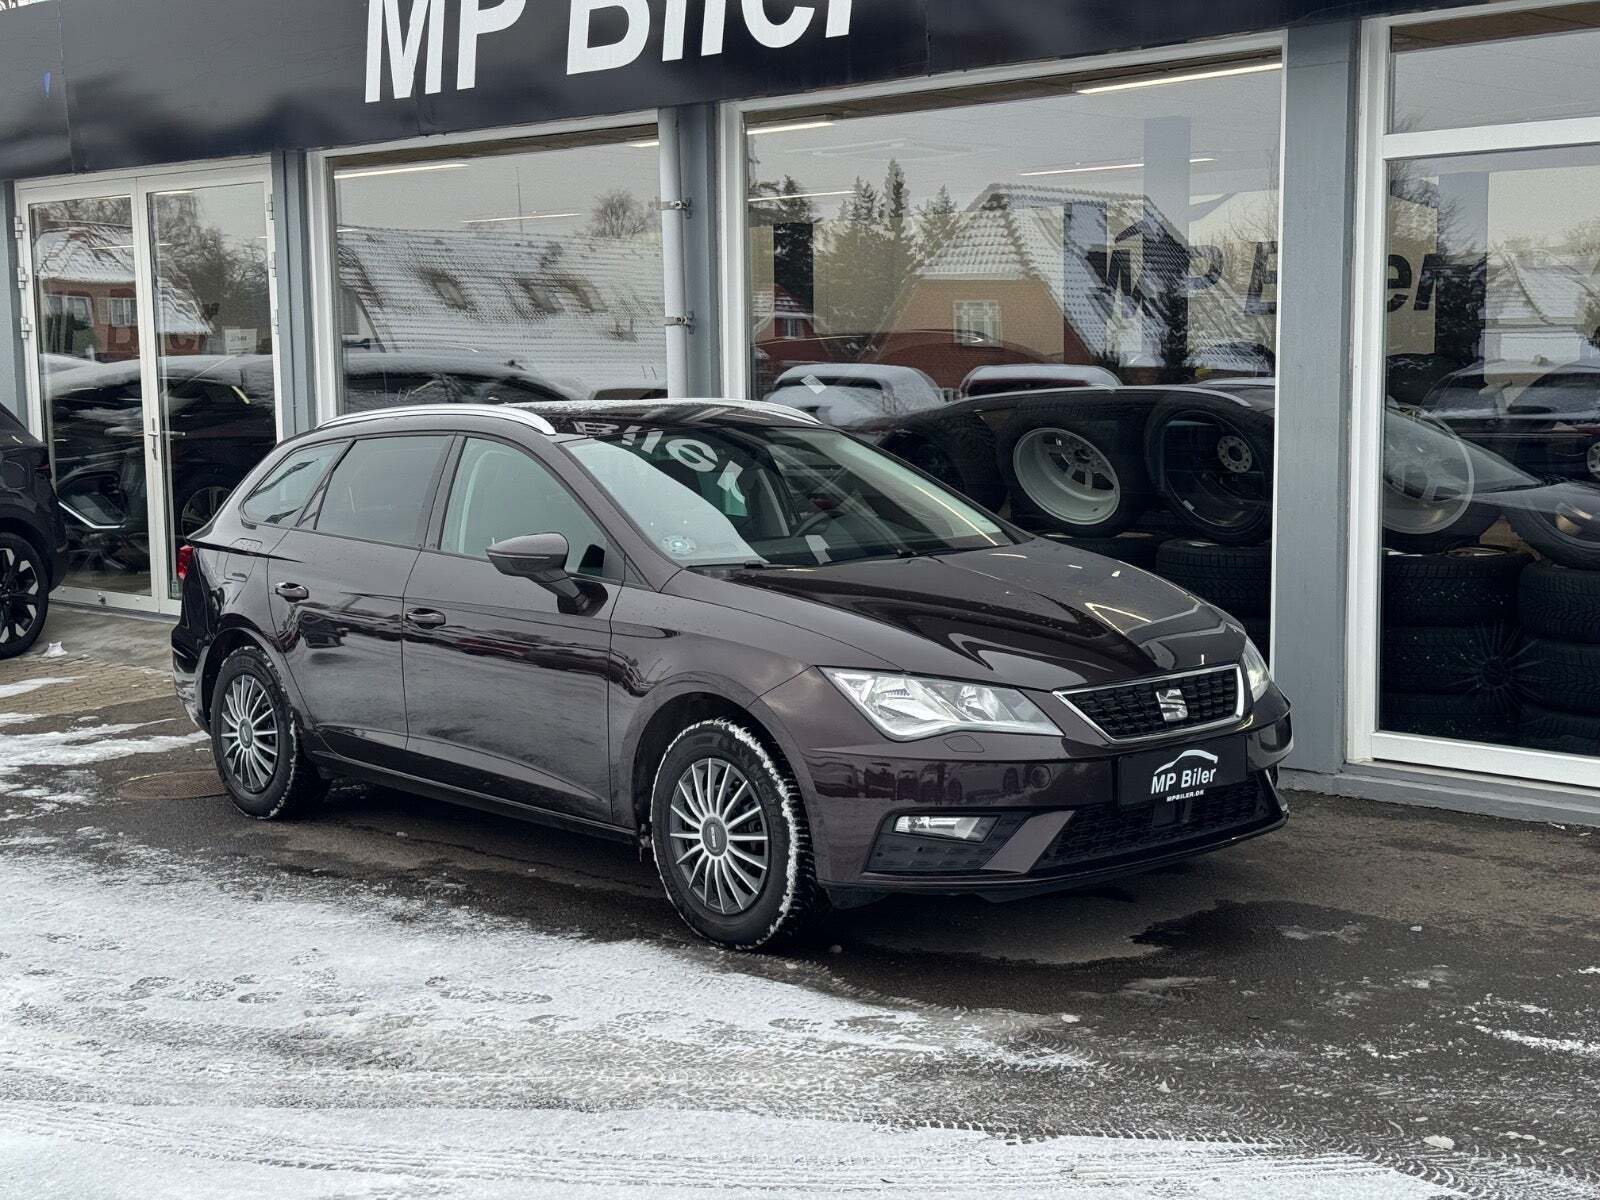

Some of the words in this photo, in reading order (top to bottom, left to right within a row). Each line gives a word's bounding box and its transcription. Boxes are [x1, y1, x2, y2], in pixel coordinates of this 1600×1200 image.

[365, 0, 527, 103] MP
[1151, 773, 1177, 794] MP
[1181, 768, 1217, 788] Biler
[1166, 789, 1205, 802] MPBILER.DK
